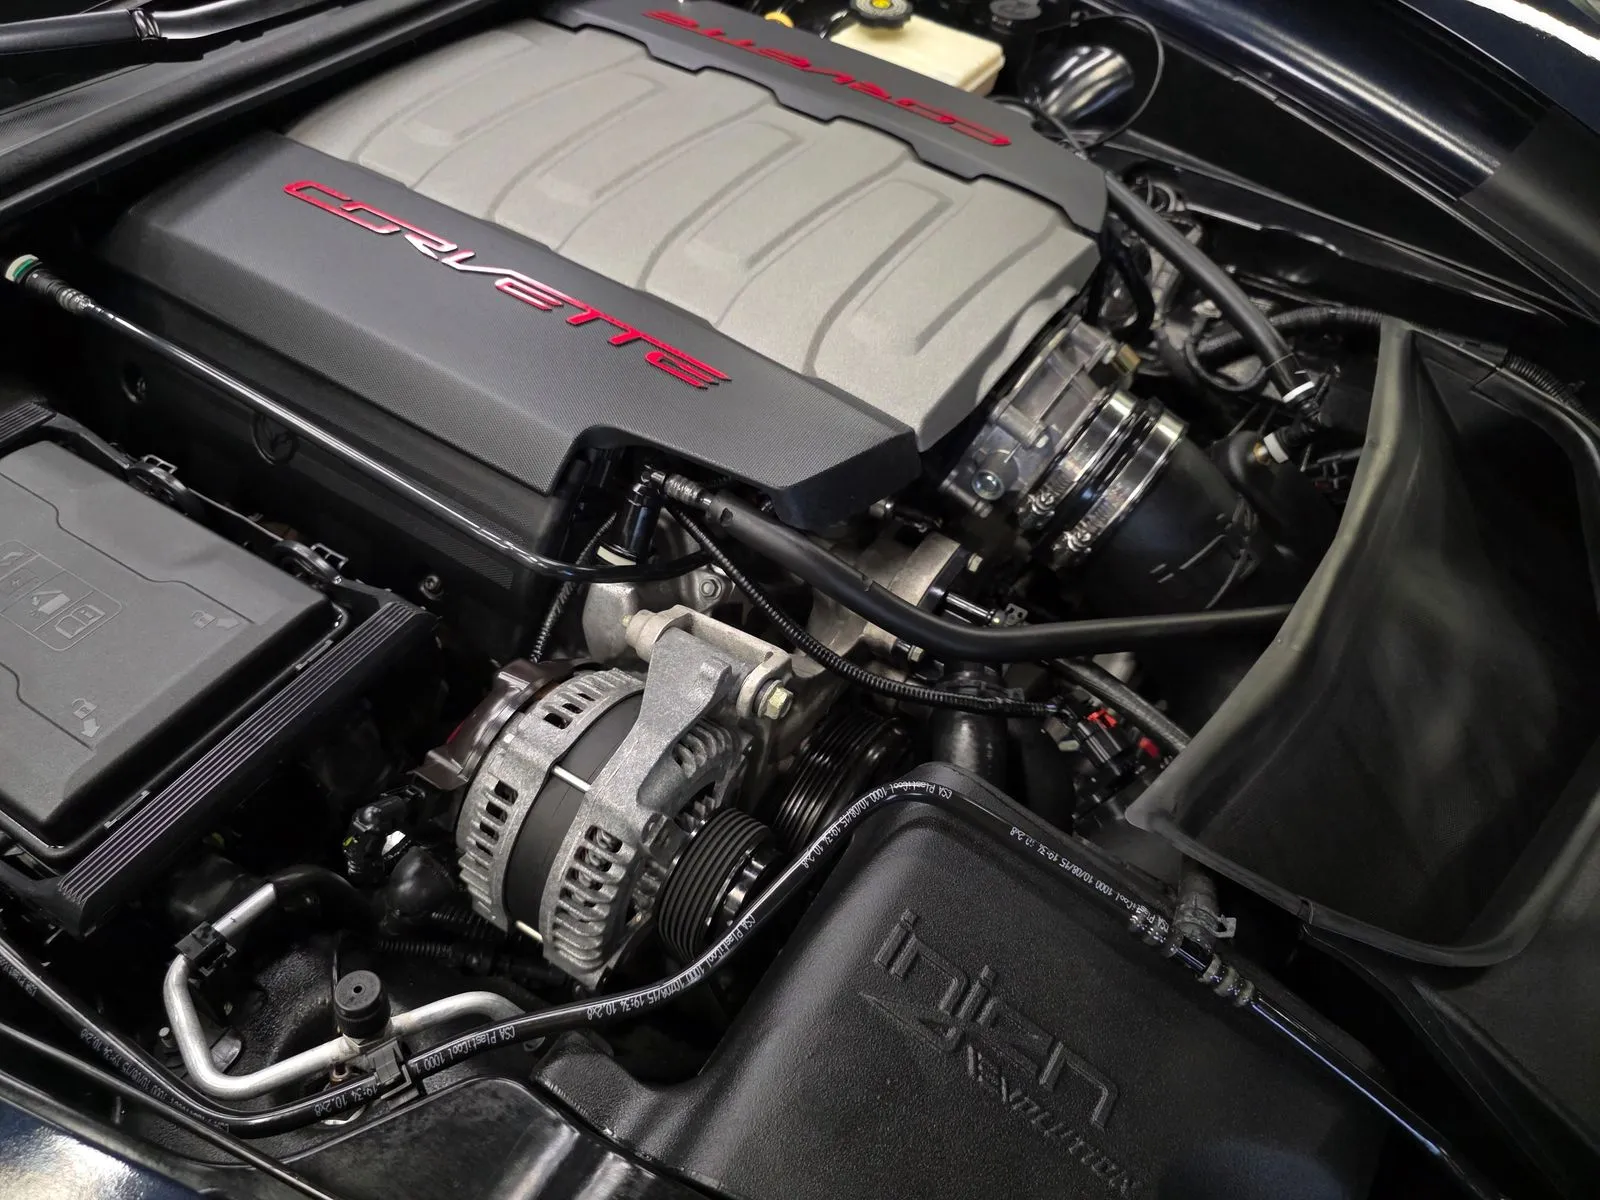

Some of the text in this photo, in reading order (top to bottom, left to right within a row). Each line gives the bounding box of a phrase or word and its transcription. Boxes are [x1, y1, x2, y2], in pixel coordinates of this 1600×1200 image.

[283, 180, 733, 389] CORVETTE
[870, 786, 888, 803] 1000
[840, 797, 871, 829] 10/08/15
[1059, 858, 1094, 884] 10/08/15
[1095, 880, 1113, 896] 1000
[742, 914, 757, 931] CSA
[686, 965, 705, 984] 1000
[648, 979, 686, 1005] 10/08/15
[586, 1001, 617, 1021] 10.2x8
[620, 996, 645, 1013] 19:34
[500, 1025, 516, 1041] CSA
[449, 1031, 497, 1061] PlastiCool
[424, 1051, 446, 1071] 1000
[314, 1085, 378, 1116] 19:34 10.2x8
